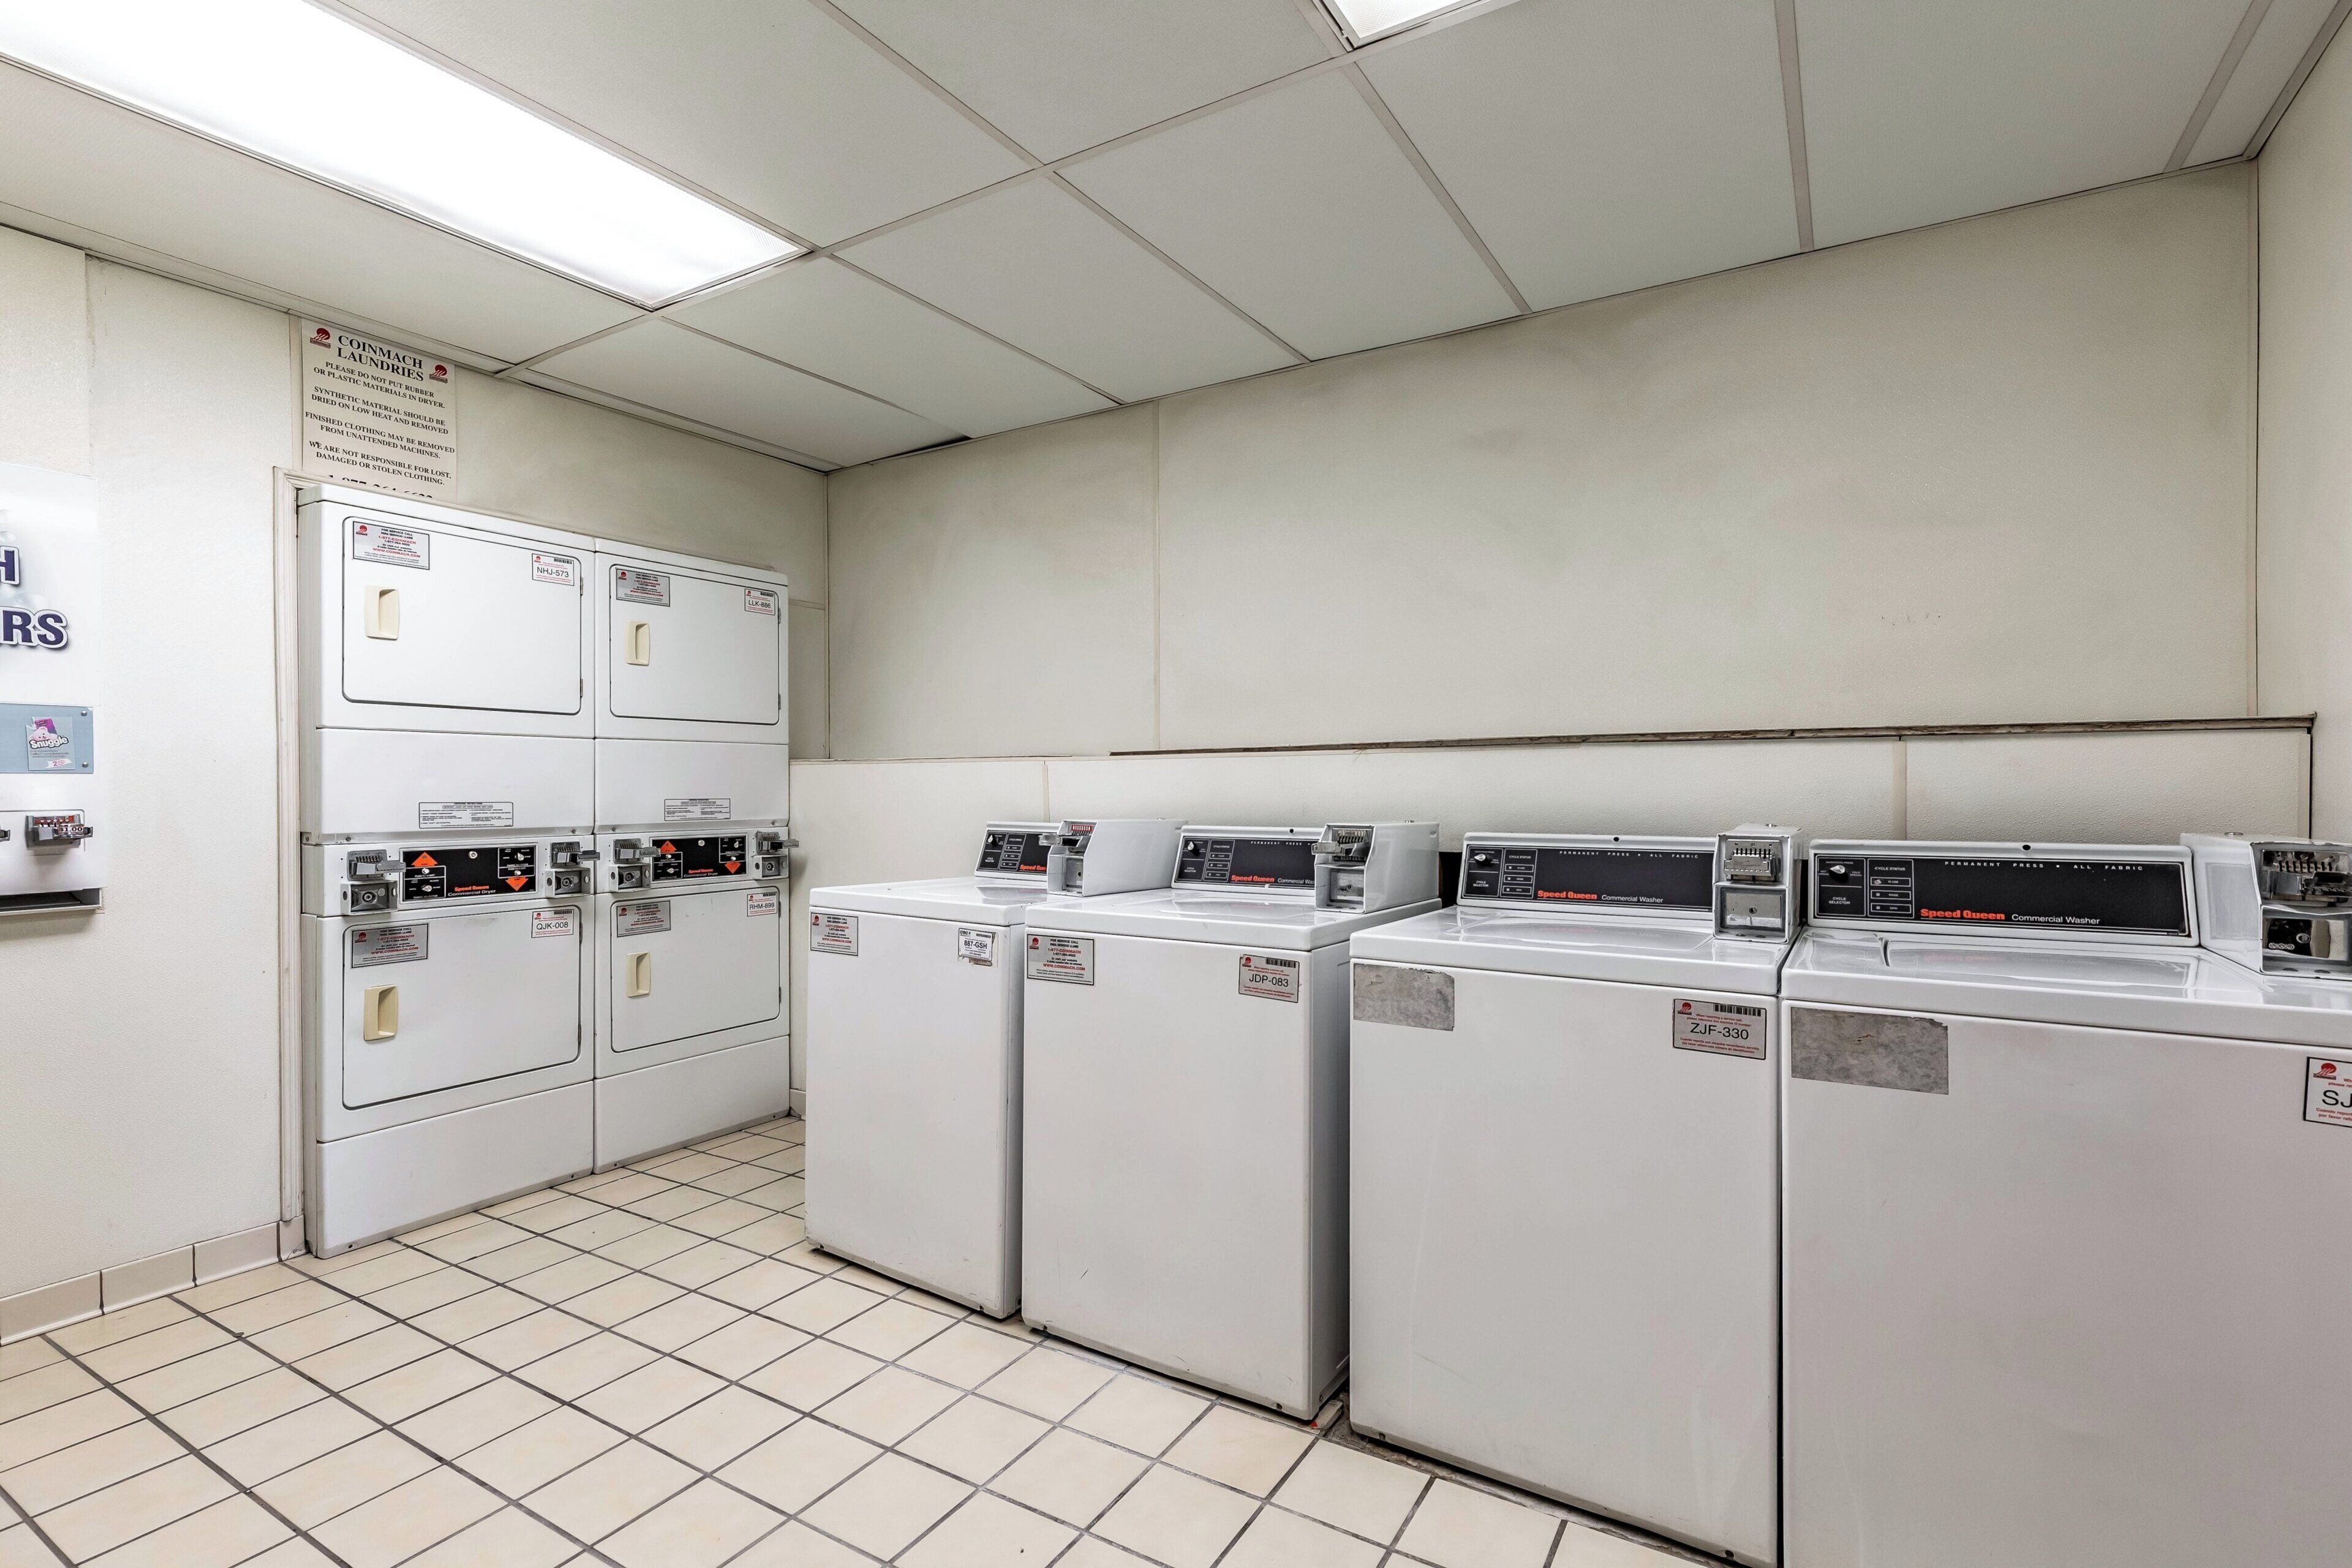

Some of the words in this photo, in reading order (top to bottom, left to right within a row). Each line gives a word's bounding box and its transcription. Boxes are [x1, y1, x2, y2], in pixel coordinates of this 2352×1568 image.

[337, 347, 424, 381] LAUNDRIES
[339, 336, 423, 369] COINMACH
[326, 362, 356, 375] PLEASE
[371, 375, 386, 383] NOT
[389, 380, 403, 389] PUT
[405, 385, 434, 398] RUBBER
[328, 371, 361, 385] PLASTIC
[363, 381, 407, 398] MATERIALS
[418, 397, 445, 409] DRYER.
[312, 394, 336, 405] DRIED
[352, 405, 370, 415] LOW
[372, 411, 392, 421] HEAT
[411, 421, 448, 434] REMOVED
[314, 386, 360, 403] SYNTHETIC
[362, 399, 402, 415] MATERIAL
[404, 411, 434, 423] SHOULD
[306, 412, 342, 426] FINISHED
[345, 423, 386, 437] CLOTHING
[388, 432, 404, 442] MAY
[418, 440, 454, 454] REMOVED
[321, 425, 344, 435] FROM
[347, 432, 398, 448] UNATTENDED
[400, 445, 440, 459] MACHINES.
[317, 452, 357, 466] DAMAGED
[372, 465, 402, 476] STOLEN
[404, 472, 445, 485] CLOTHING.
[342, 449, 358, 458] NOT
[361, 453, 412, 470] RESPONSIBLE
[431, 470, 451, 479] LOST,
[537, 567, 568, 577] NHJ-573
[748, 600, 771, 608] LLK-886
[29, 736, 69, 748] Snuggle
[1920, 908, 1961, 918] Speed
[1963, 910, 2005, 919] Queen
[2011, 914, 2064, 922] Commercial
[964, 940, 987, 949] 887-GSH
[1249, 974, 1289, 987] JDP-083
[1691, 1022, 1749, 1039] ZJF-330
